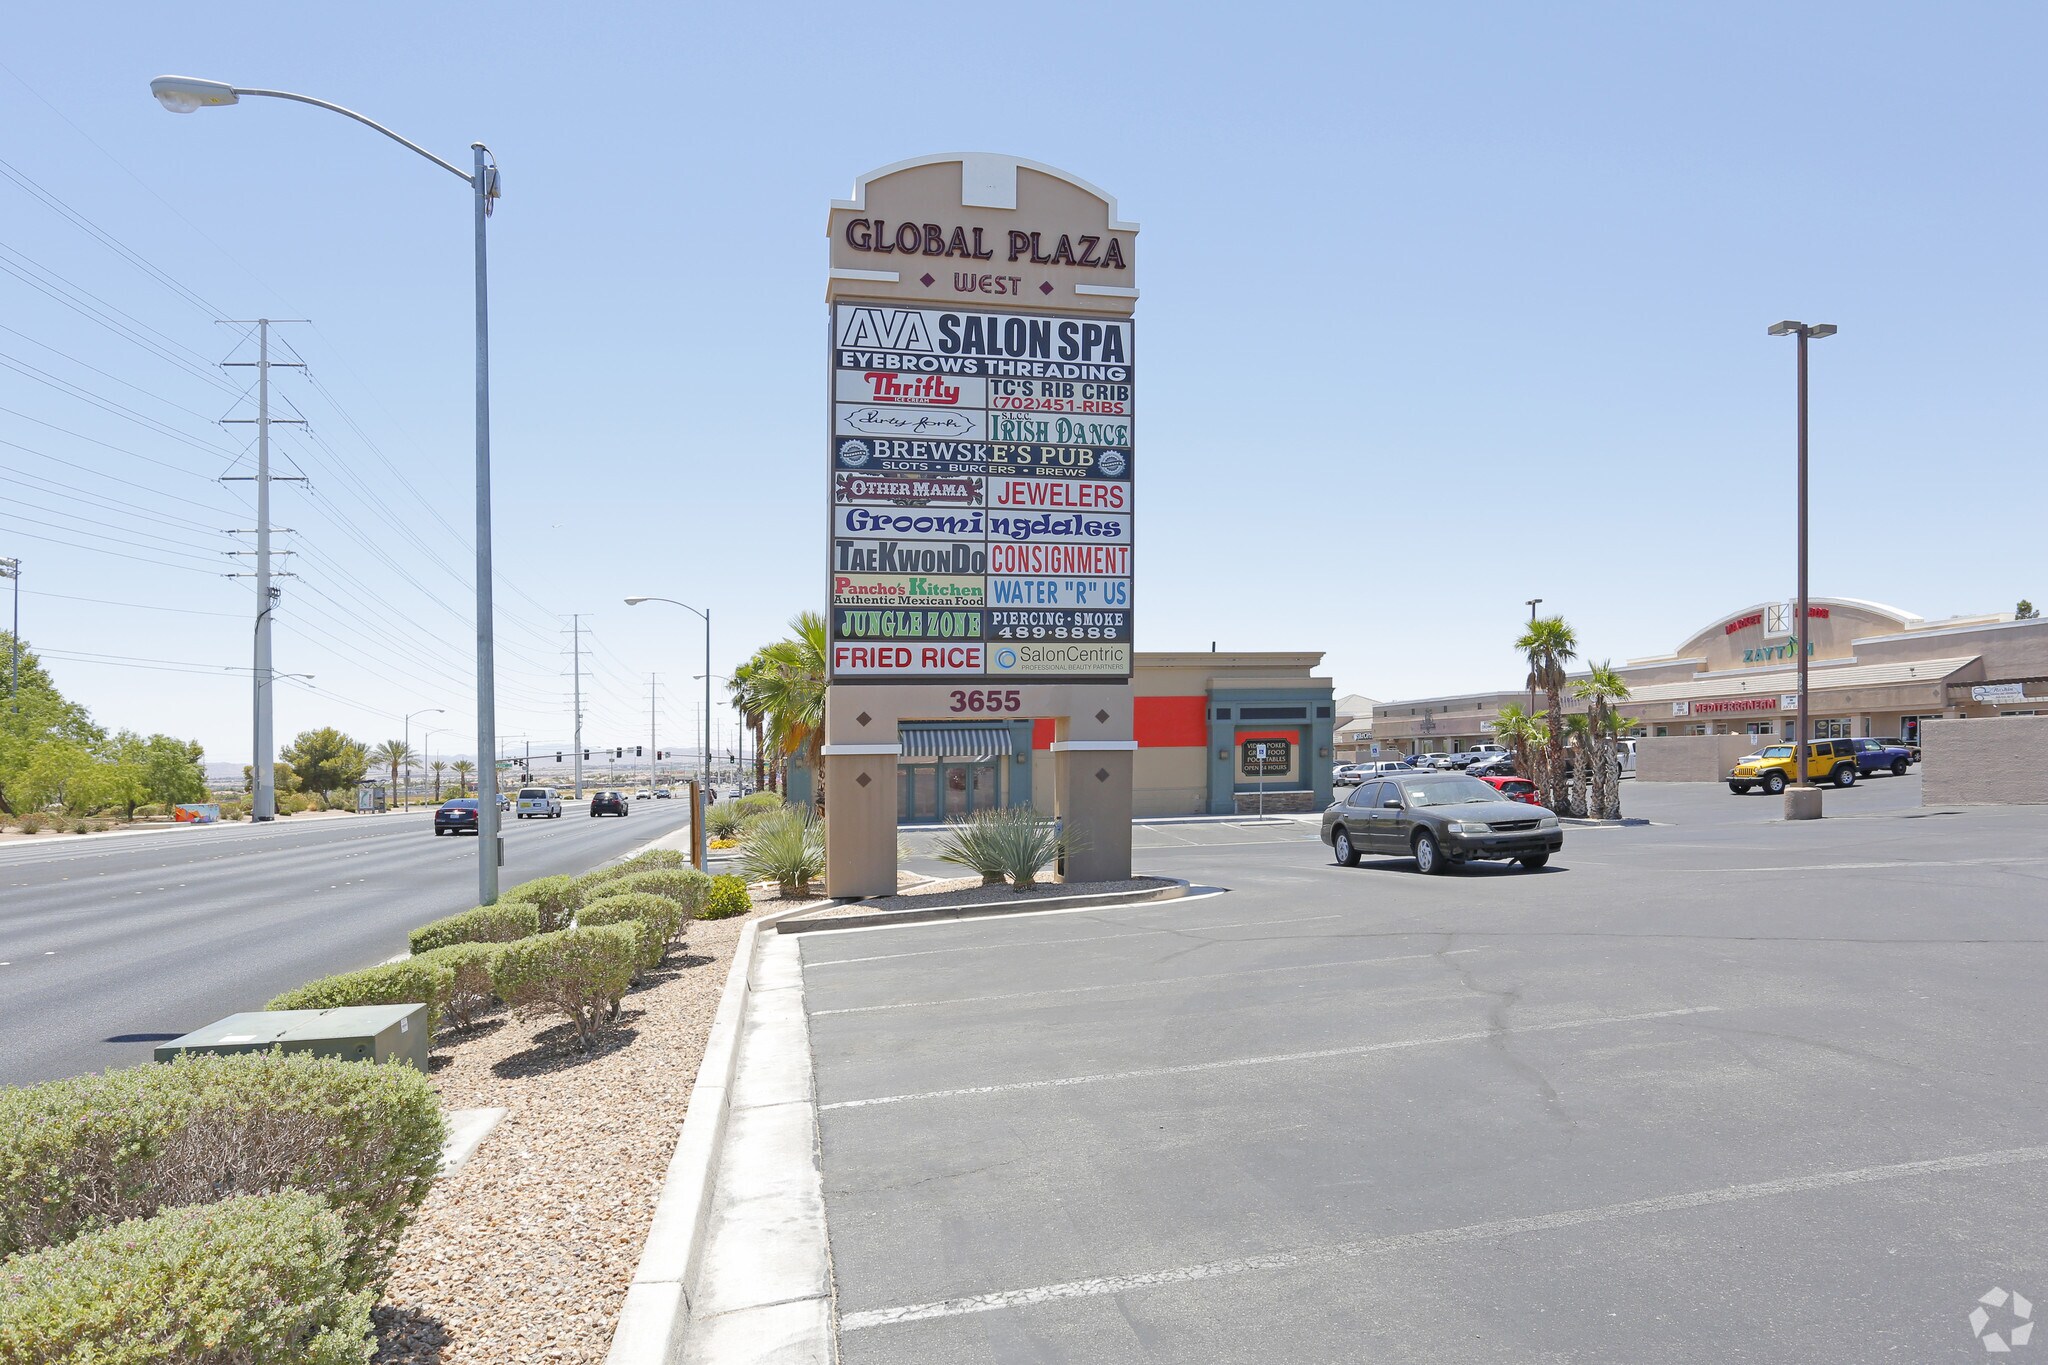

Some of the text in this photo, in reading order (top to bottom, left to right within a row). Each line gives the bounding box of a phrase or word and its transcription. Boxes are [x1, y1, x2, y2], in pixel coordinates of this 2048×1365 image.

[845, 218, 1127, 269] GLOBAL PLAZA
[954, 272, 1021, 295] WEST
[841, 307, 1125, 364] AVA SALON SPA
[841, 352, 1127, 382] EYEBROWS THREADING
[864, 371, 960, 405] Thrifty
[990, 379, 1129, 402] TC'S RIB CRIB
[990, 414, 1129, 447] IRISH DANCE
[1040, 447, 1094, 466] PUB
[882, 461, 928, 471] SLOTS
[1036, 467, 1086, 477] BREWS
[850, 479, 968, 497] OTHER MAMA
[997, 481, 1124, 509] JEWELERS
[991, 545, 1128, 575] CONSIGNMENT
[835, 576, 983, 597] Pancho's Kitchen
[993, 579, 1058, 605] WATER
[1103, 580, 1127, 606] US
[834, 594, 984, 606] Authentic Mexican Food
[841, 610, 981, 638] JUNGLE ZONE
[1725, 614, 1762, 635] MARKET
[835, 646, 981, 669] FRIED RICE
[1020, 645, 1124, 662] SalonCentric
[949, 689, 1021, 713] 3655
[1695, 698, 1776, 713] MEDITERRANEAN
